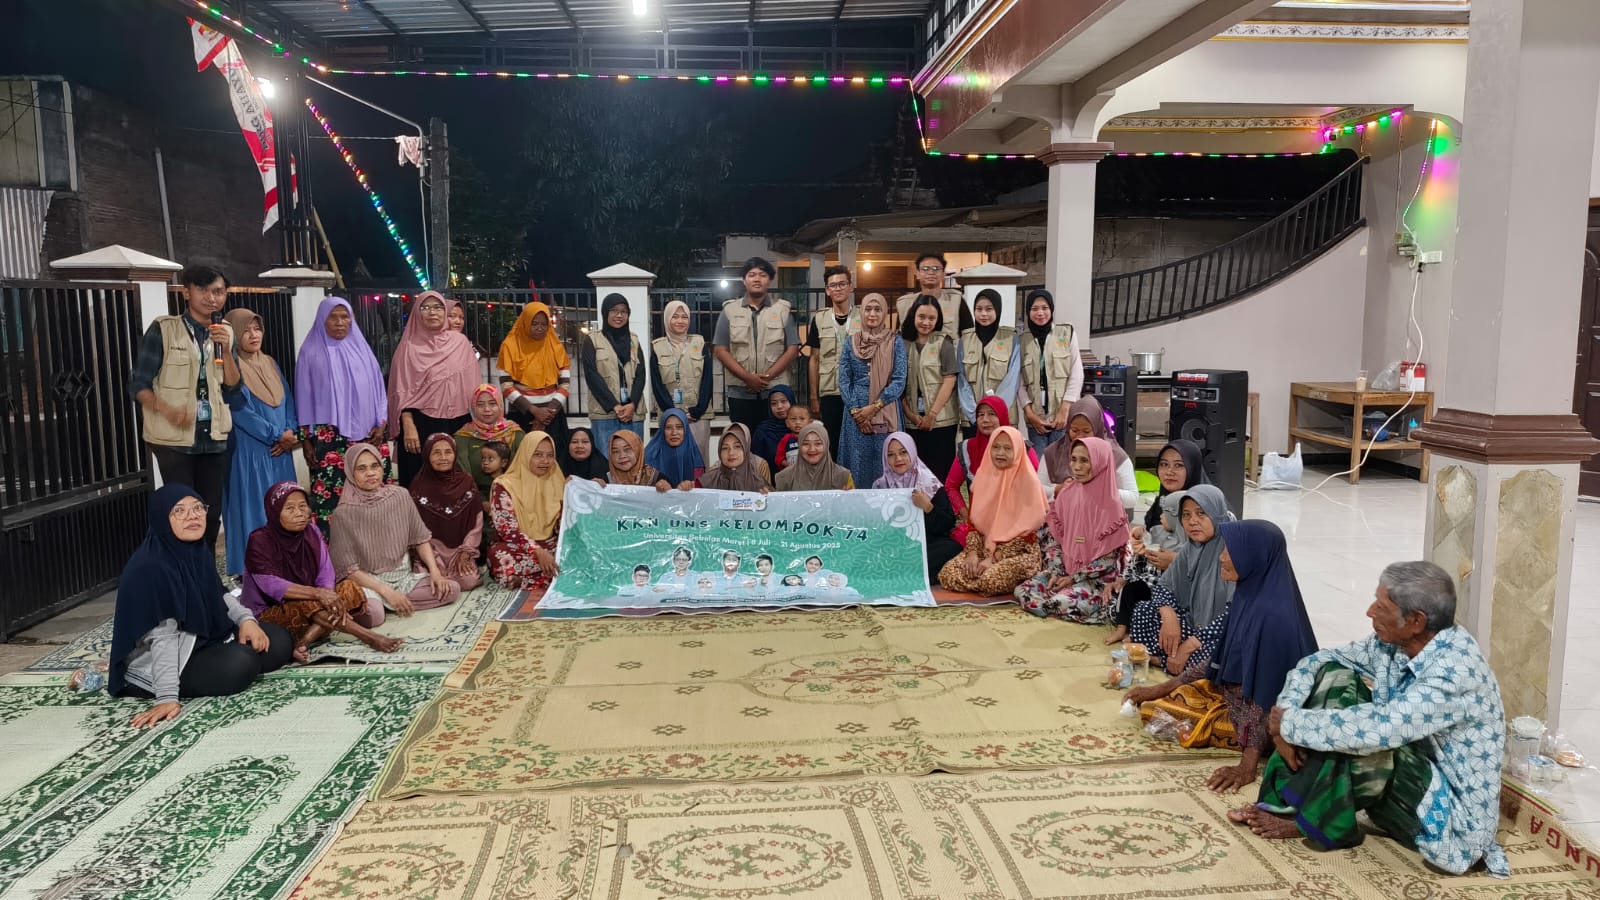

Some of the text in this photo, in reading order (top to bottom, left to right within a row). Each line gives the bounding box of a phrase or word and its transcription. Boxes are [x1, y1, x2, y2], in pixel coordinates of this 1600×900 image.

[617, 518, 867, 541] KKN UNS KELOMPOK 74
[643, 532, 687, 541] Universitas
[758, 537, 771, 546] Juli
[789, 541, 820, 551] Agustus
